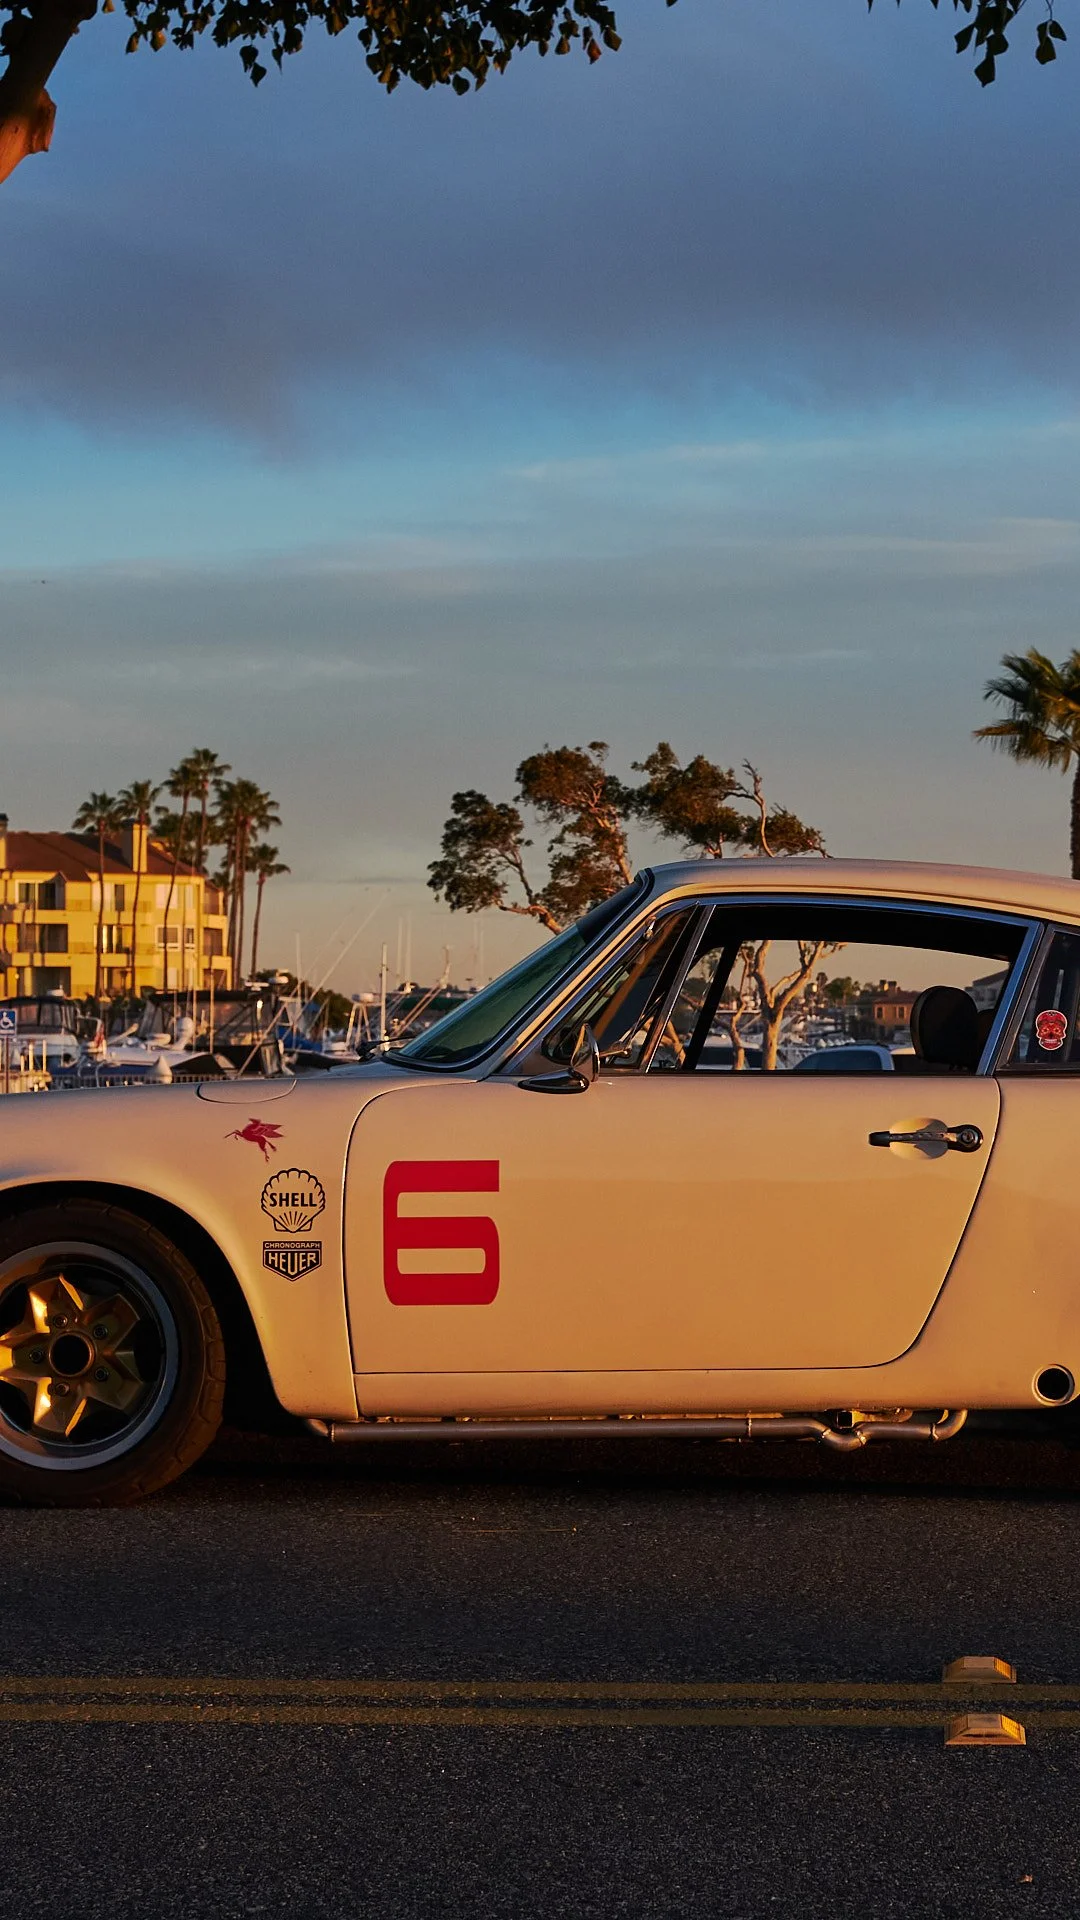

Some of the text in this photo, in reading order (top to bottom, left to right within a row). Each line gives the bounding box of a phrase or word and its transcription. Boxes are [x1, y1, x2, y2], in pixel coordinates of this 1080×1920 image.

[269, 1192, 318, 1208] SHELL
[383, 1160, 500, 1306] 6
[268, 1252, 317, 1276] HEUER
